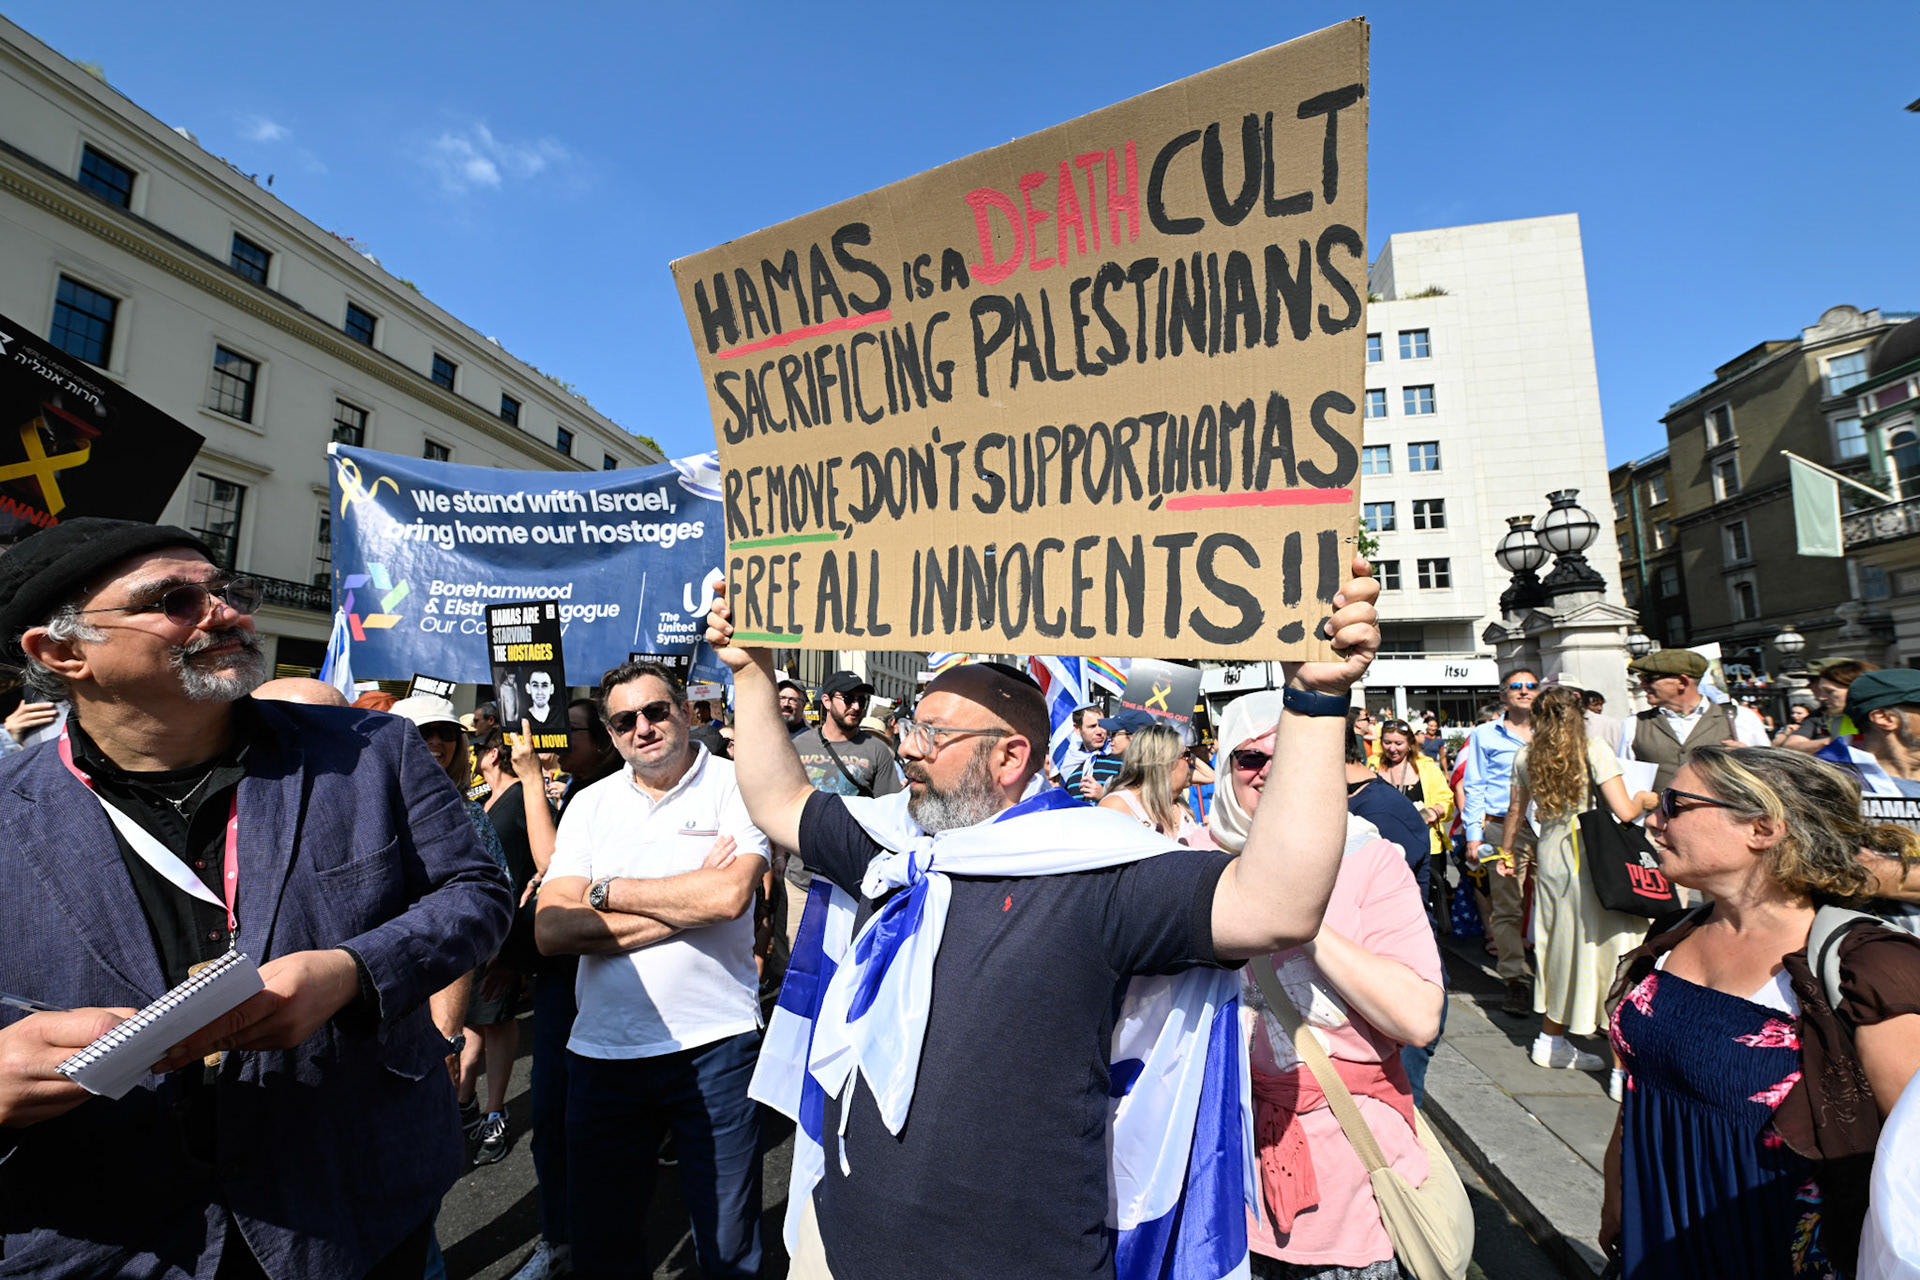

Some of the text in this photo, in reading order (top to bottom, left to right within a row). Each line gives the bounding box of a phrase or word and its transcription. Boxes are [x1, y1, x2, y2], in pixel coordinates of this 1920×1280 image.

[695, 84, 1365, 354] HAMAS IS A DEATH CULT
[715, 224, 1364, 445] SACRIFICING PALESTINIANS
[848, 426, 967, 524] DON'T
[1162, 390, 1357, 494] HAMAS
[411, 486, 676, 515] We stand with Israel,
[455, 520, 528, 544] home
[531, 525, 577, 544] our
[580, 520, 704, 549] hostages
[429, 580, 573, 599] Borehamwood
[730, 551, 802, 636] FREE
[815, 549, 891, 638] ALL
[424, 598, 440, 614] &
[444, 599, 487, 616] Elstr
[491, 607, 521, 626] HAMAS
[522, 606, 540, 624] ARE
[420, 616, 457, 633] Our
[659, 612, 680, 622] The
[492, 625, 532, 644] STARVING
[658, 622, 696, 633] United
[656, 633, 708, 645] Synago
[493, 643, 553, 662] THE HOSTAGES
[1445, 665, 1469, 677] itsu
[1175, 713, 1189, 722] OUT
[541, 734, 569, 748] NOW!
